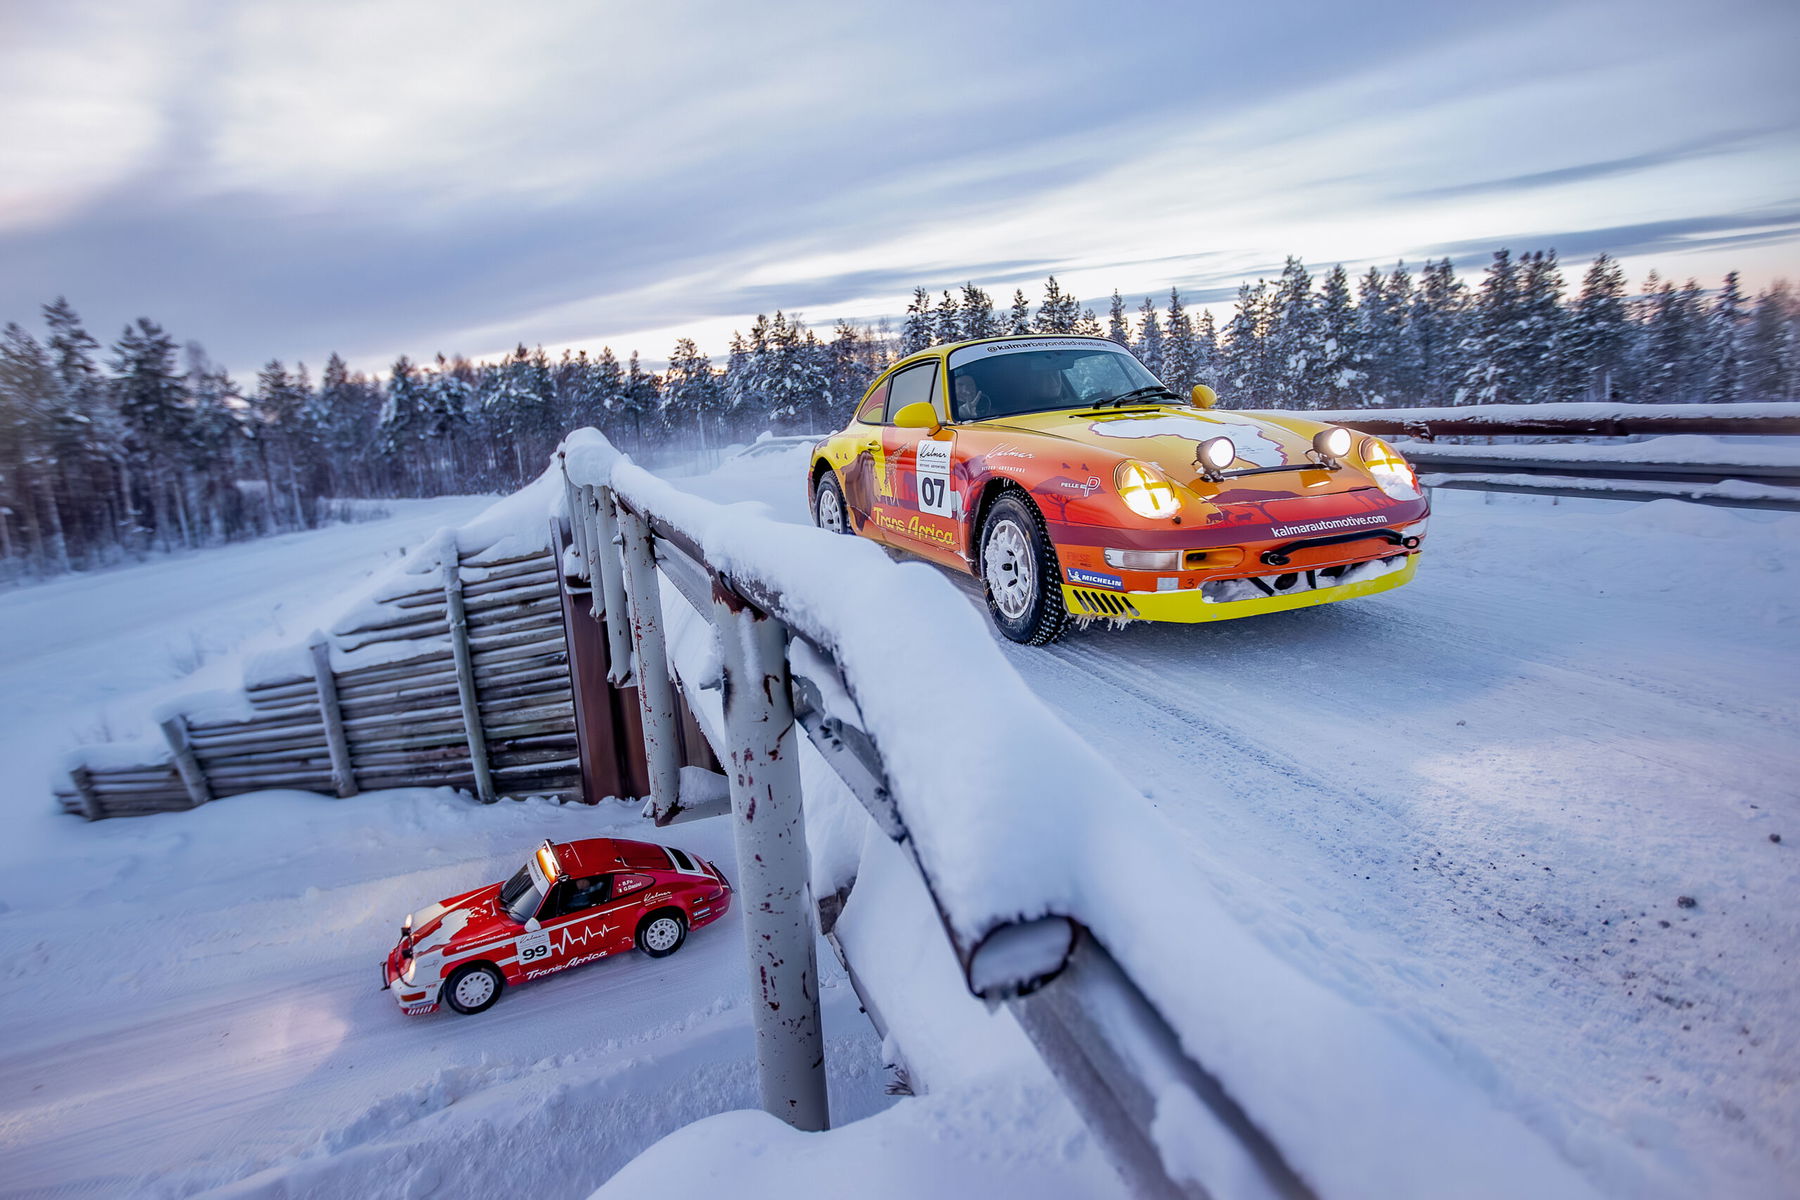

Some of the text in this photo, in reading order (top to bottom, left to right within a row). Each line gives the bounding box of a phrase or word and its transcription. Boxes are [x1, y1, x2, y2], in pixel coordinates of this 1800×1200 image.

[921, 476, 946, 509] 07
[872, 506, 957, 546] Trans Africa
[1270, 514, 1389, 538] kalmarautomotive.com
[1081, 574, 1123, 588] MICHELIN
[522, 945, 548, 960] 99
